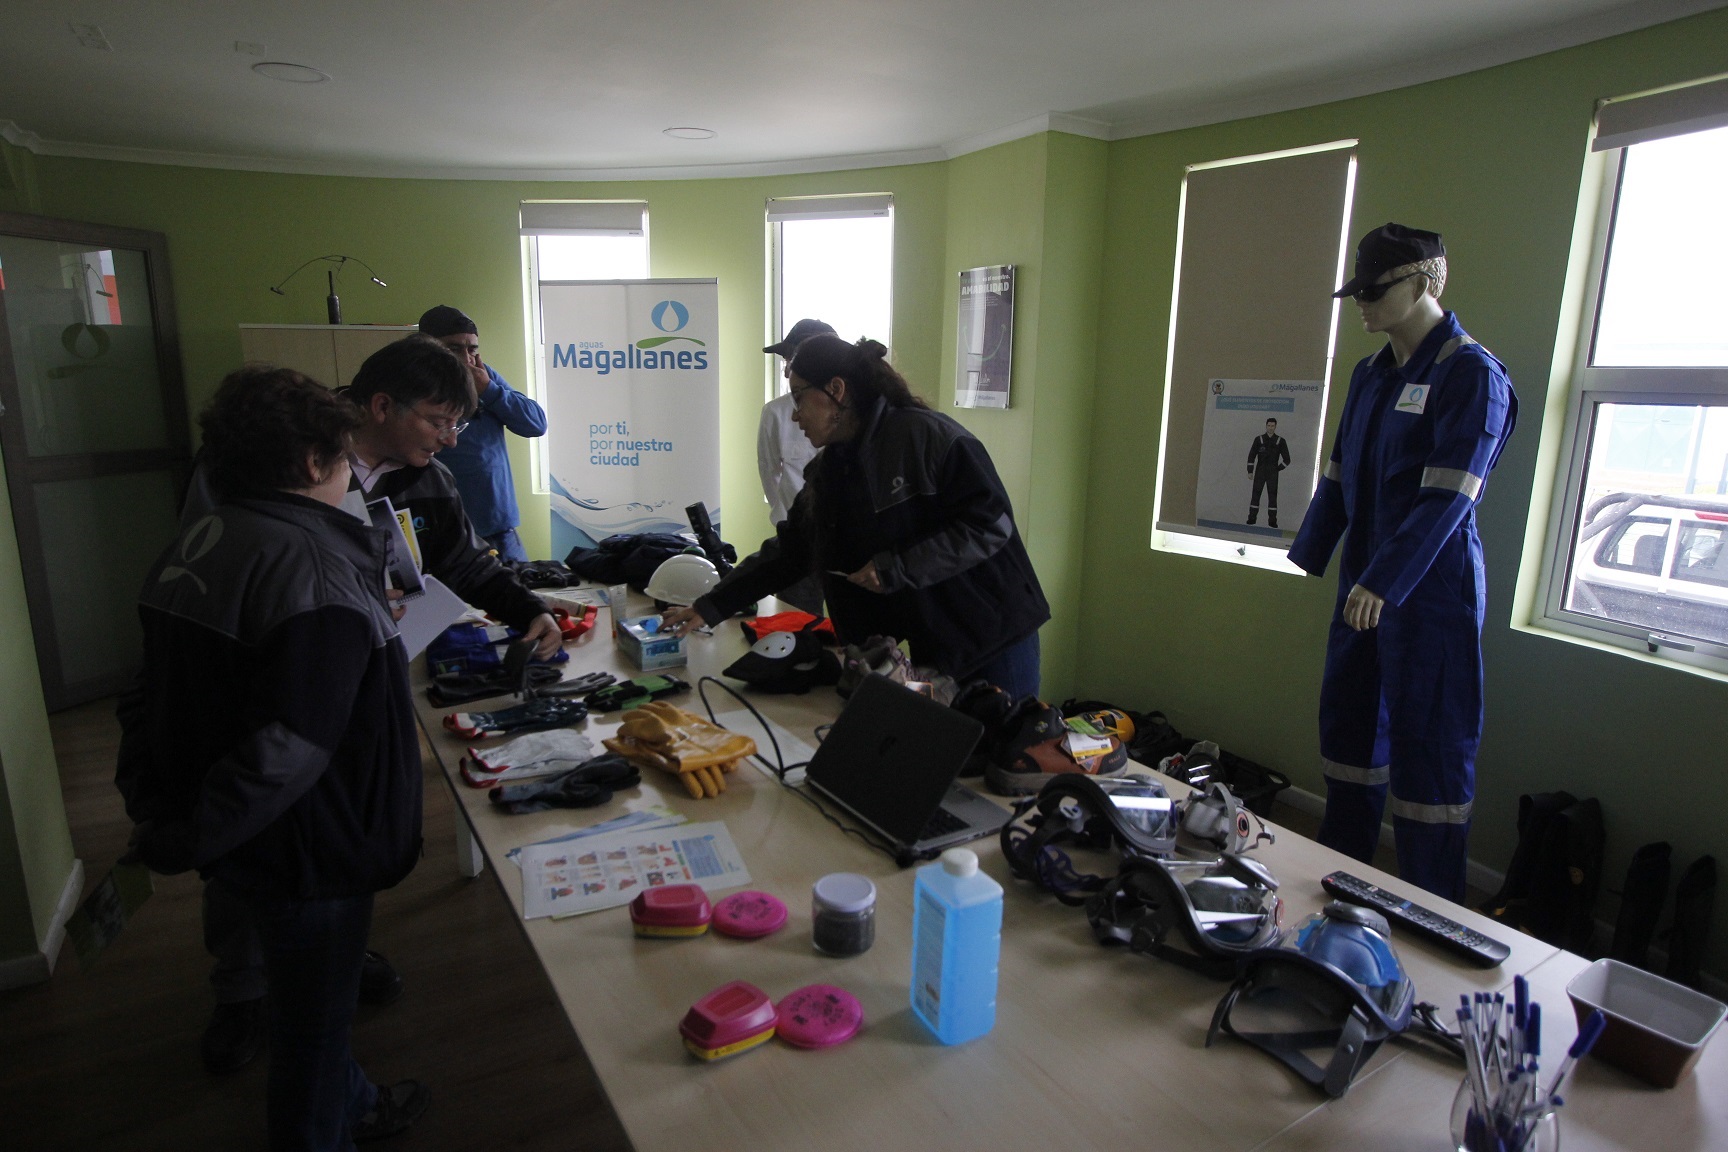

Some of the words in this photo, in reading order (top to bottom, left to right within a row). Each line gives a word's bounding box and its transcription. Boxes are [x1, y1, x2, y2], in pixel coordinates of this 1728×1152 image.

[961, 282, 1010, 295] AMABILIDAD
[578, 341, 604, 349] aguas
[553, 343, 708, 375] Magallanes
[1279, 384, 1319, 393] Magallanes
[589, 423, 613, 438] por
[616, 421, 630, 437] ti,
[590, 439, 613, 453] por
[616, 438, 673, 452] nuestra
[590, 452, 640, 467] ciudad
